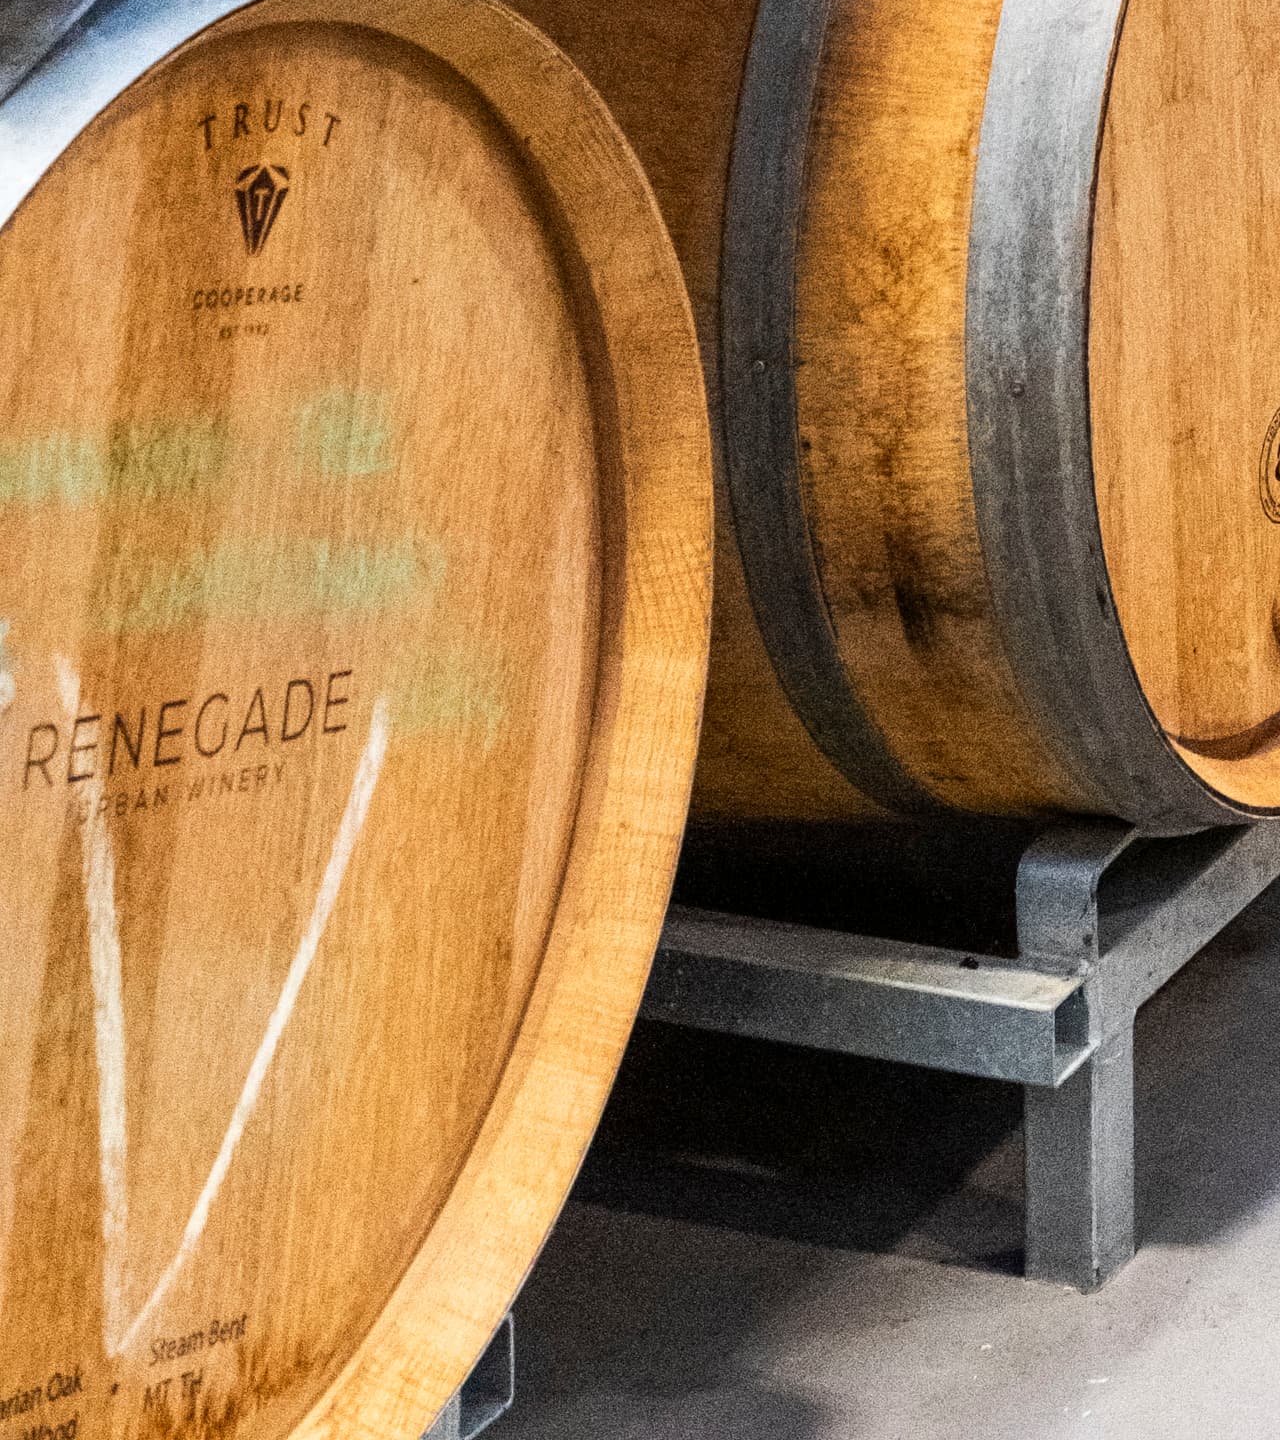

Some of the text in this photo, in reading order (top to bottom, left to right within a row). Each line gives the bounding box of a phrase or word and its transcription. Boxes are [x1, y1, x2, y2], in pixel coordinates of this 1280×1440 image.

[198, 98, 341, 151] TRUST
[191, 283, 304, 311] COOPERAGE
[21, 668, 353, 791] RENEGADE
[150, 1312, 249, 1367] Steam Bent
[46, 1364, 84, 1402] Oak
